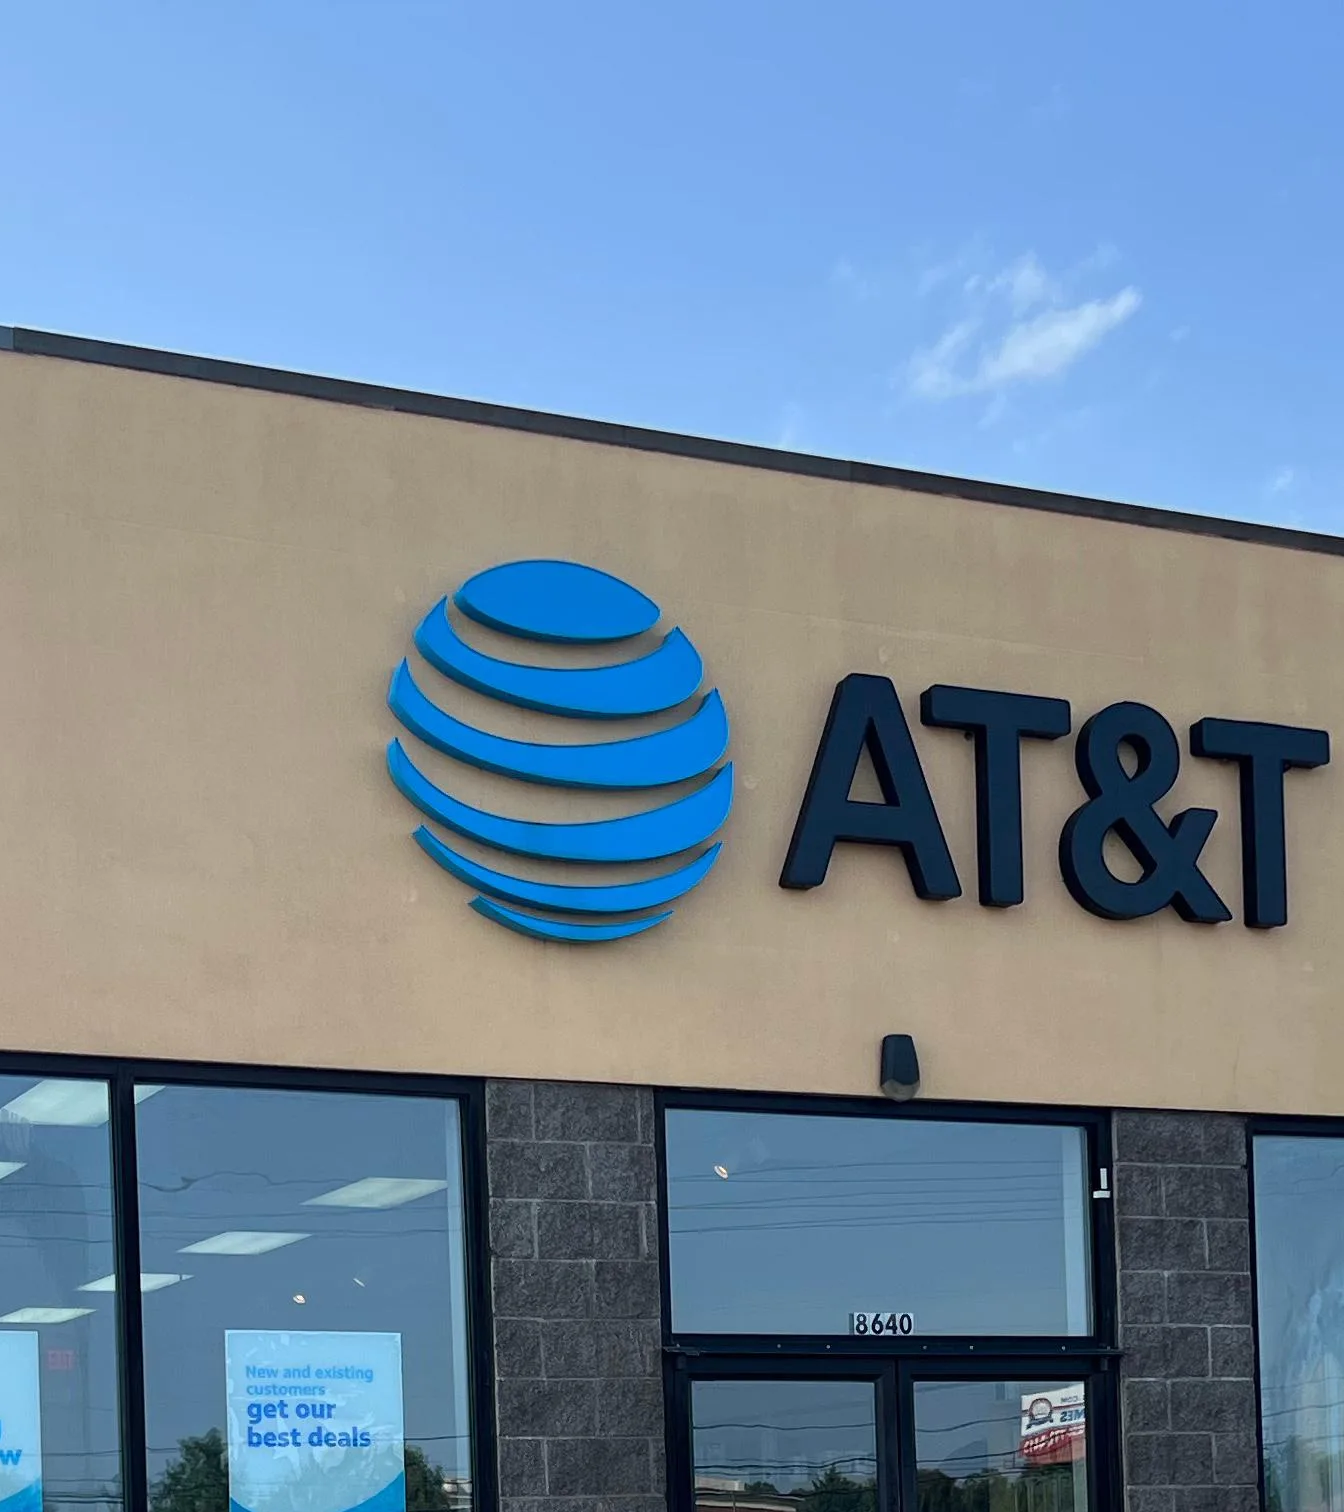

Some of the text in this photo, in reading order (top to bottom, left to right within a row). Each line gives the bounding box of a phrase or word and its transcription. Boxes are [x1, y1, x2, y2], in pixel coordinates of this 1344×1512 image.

[778, 672, 1330, 929] AT&T
[856, 1313, 912, 1335] 8640
[245, 1365, 374, 1383] New and existing
[246, 1384, 325, 1396] customers
[247, 1400, 336, 1424] get our
[247, 1426, 371, 1447] best deals
